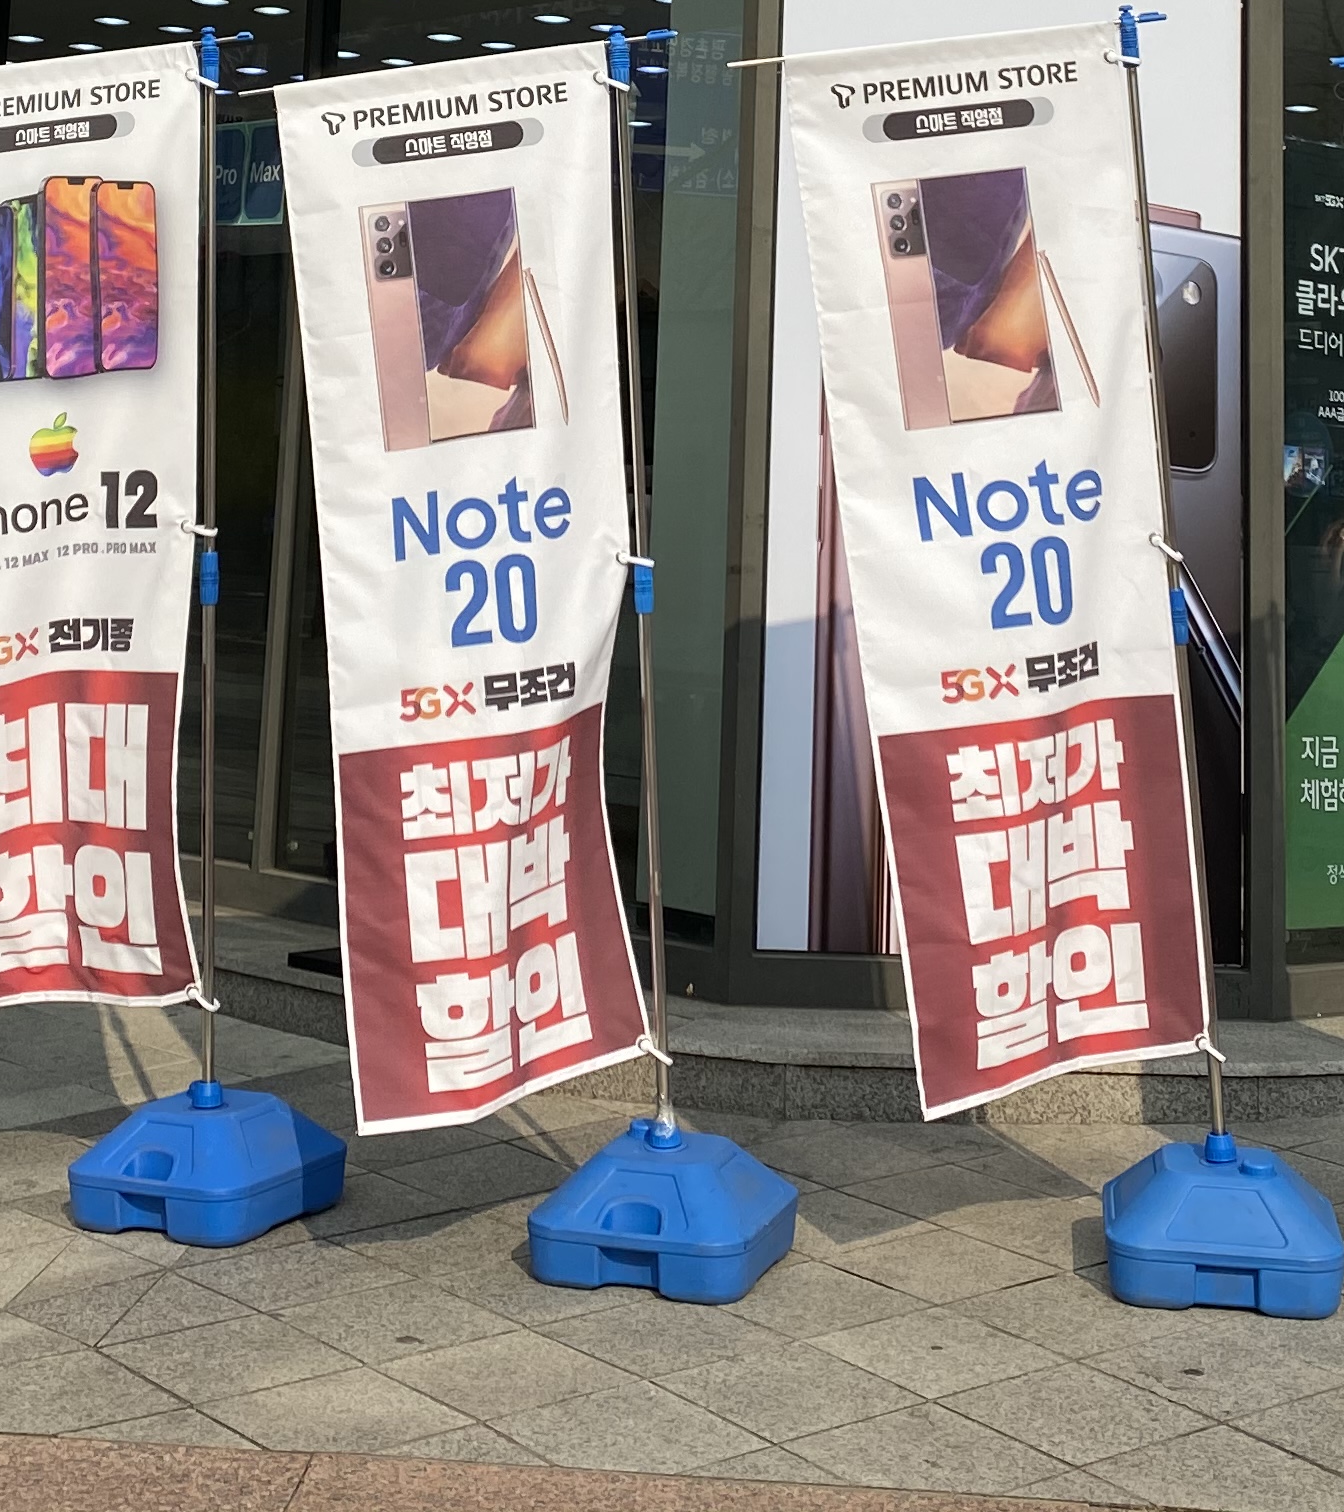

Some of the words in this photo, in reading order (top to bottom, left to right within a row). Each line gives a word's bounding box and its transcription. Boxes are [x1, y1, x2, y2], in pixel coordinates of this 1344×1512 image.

[90, 79, 161, 106] STORE
[353, 93, 478, 130] PREMIUM
[488, 81, 568, 113] STORE
[863, 70, 988, 105] PREMIUM
[998, 60, 1078, 90] STORE
[15, 125, 51, 147] 스마트
[53, 121, 90, 141] 직영점
[405, 135, 447, 157] 스마트
[450, 129, 493, 152] 직영점
[915, 112, 957, 134] 스마트
[961, 106, 1003, 129] 직영점
[250, 161, 281, 184] Max
[1298, 328, 1344, 358] 드디어
[1318, 405, 1344, 423] AAA급
[100, 469, 159, 529] 12
[391, 476, 572, 562] Note
[912, 458, 1103, 542] Note
[23, 550, 49, 567] MAX
[130, 541, 157, 554] MAX
[980, 536, 1073, 630] 20
[445, 553, 538, 648] 20
[49, 618, 134, 654] 전기종
[399, 681, 476, 722] 5GX
[484, 661, 575, 712] 무조건
[941, 663, 1019, 705] 5GX
[1025, 641, 1100, 692] 무조건
[946, 718, 1125, 822] 최저가
[1301, 736, 1339, 769] 지금
[400, 735, 572, 840] 최저가
[403, 814, 571, 965] 대박
[954, 799, 1134, 946] 대박
[416, 931, 593, 1093] 할인
[972, 922, 1150, 1071] 할인
